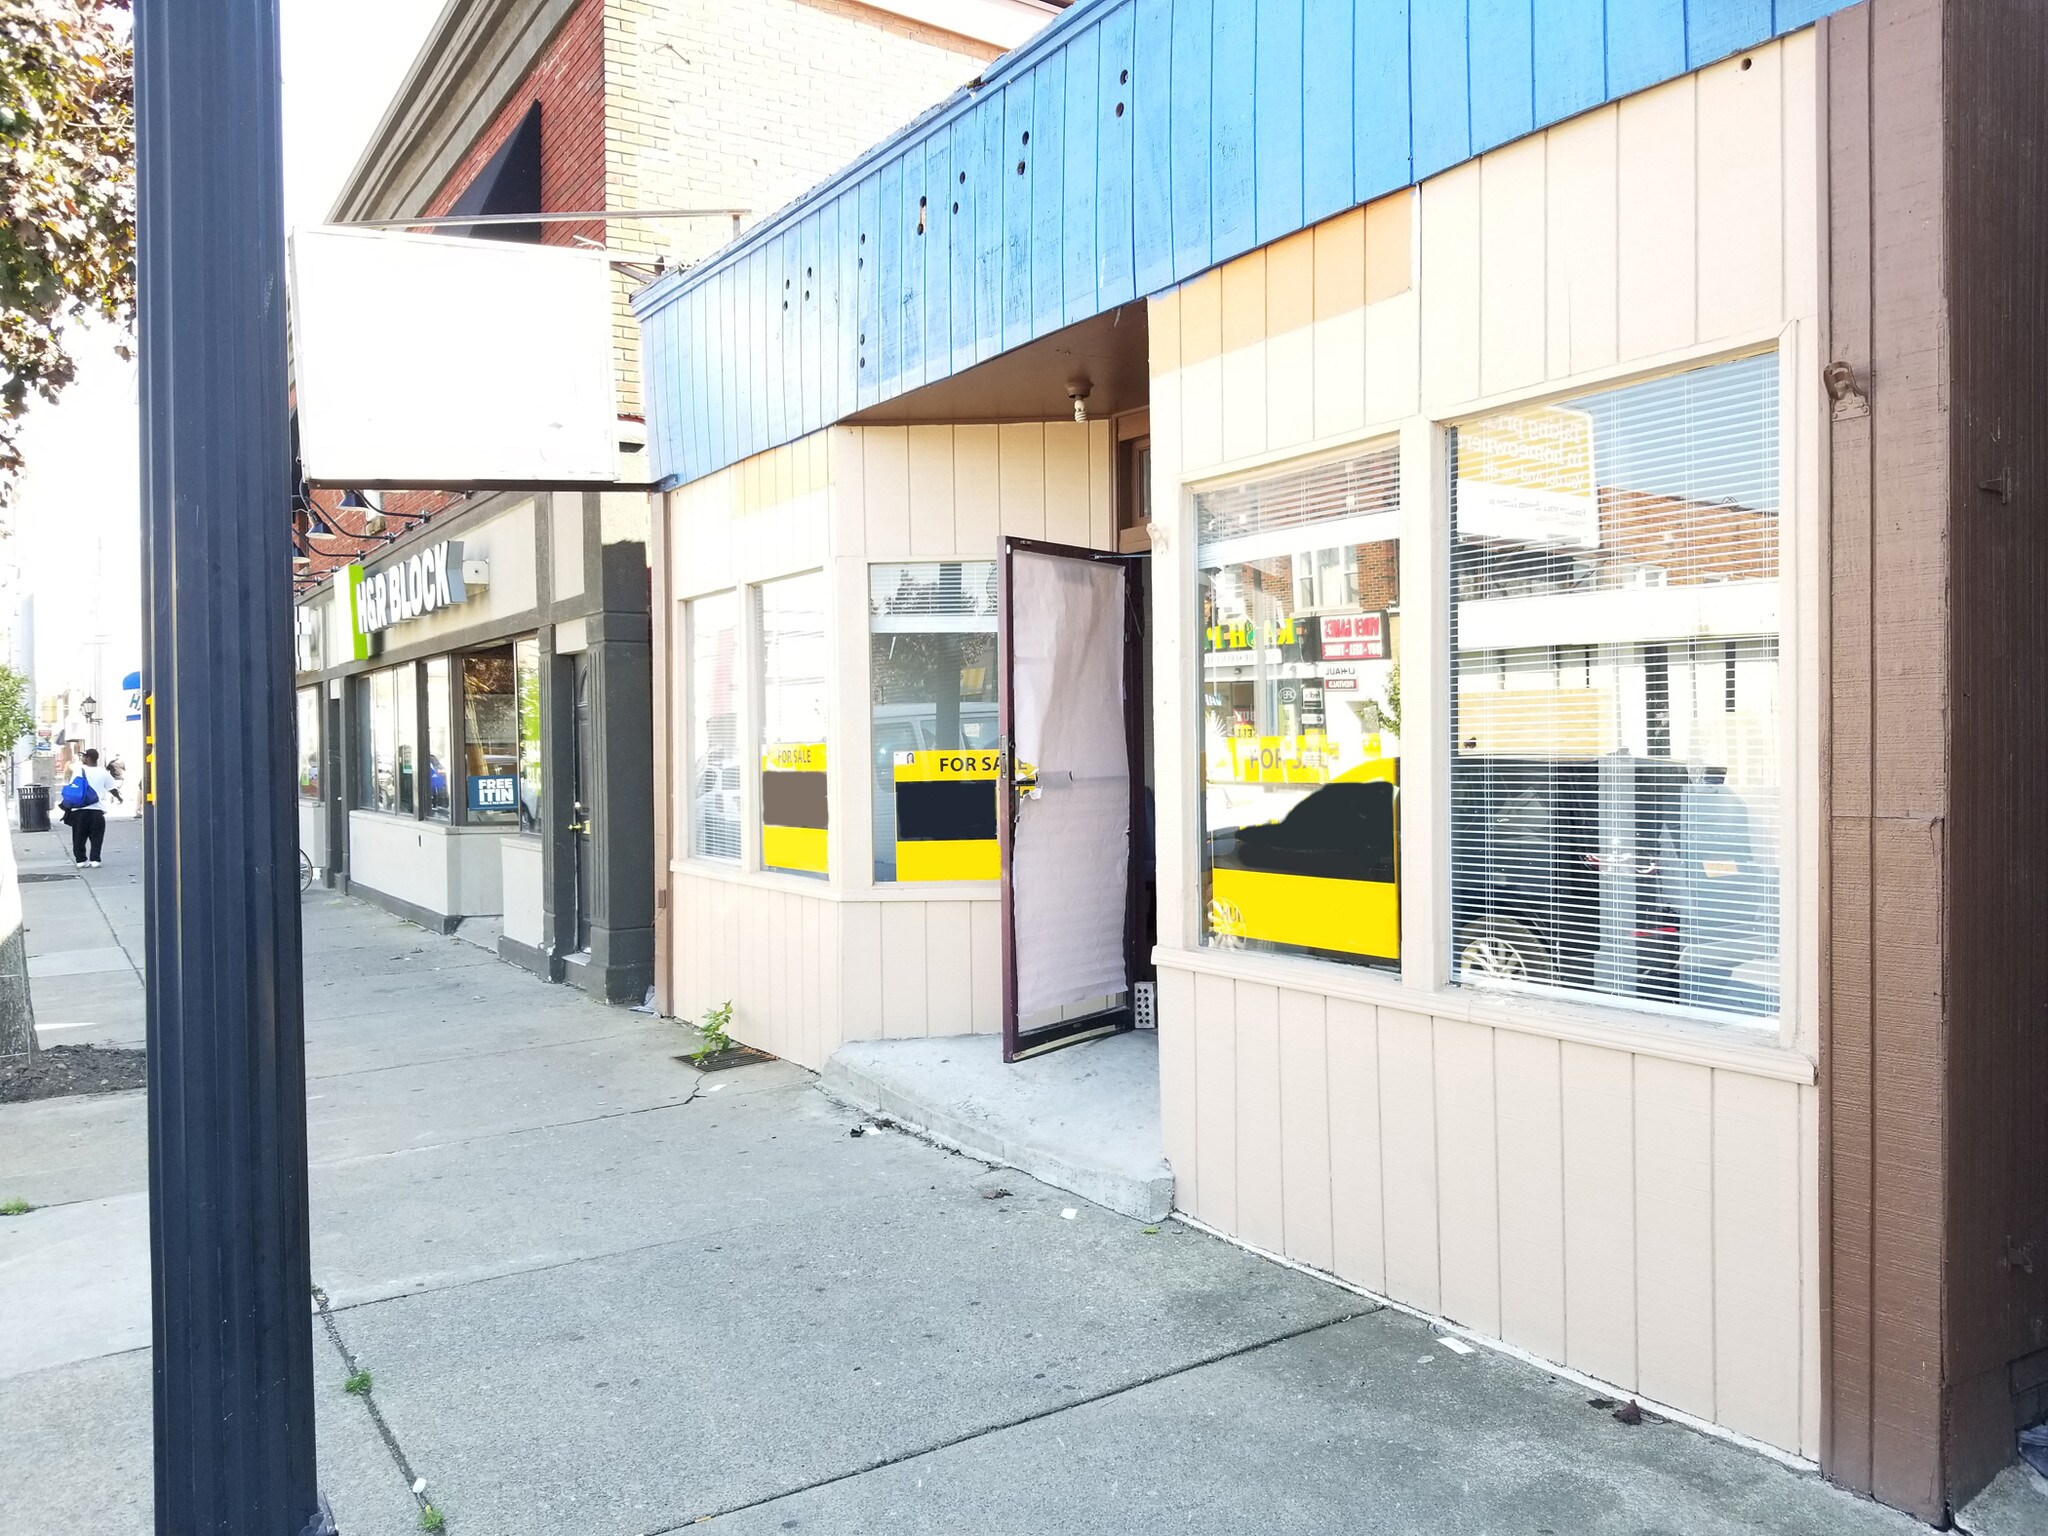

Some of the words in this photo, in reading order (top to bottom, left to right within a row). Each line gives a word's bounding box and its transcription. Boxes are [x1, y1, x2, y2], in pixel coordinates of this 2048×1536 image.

[355, 574, 388, 634] H&R
[389, 540, 451, 621] BLOCK
[777, 750, 791, 764] FOR
[793, 749, 811, 763] SALE
[939, 757, 976, 772] FOR
[478, 778, 513, 789] FREE
[478, 788, 514, 802] ITIN
